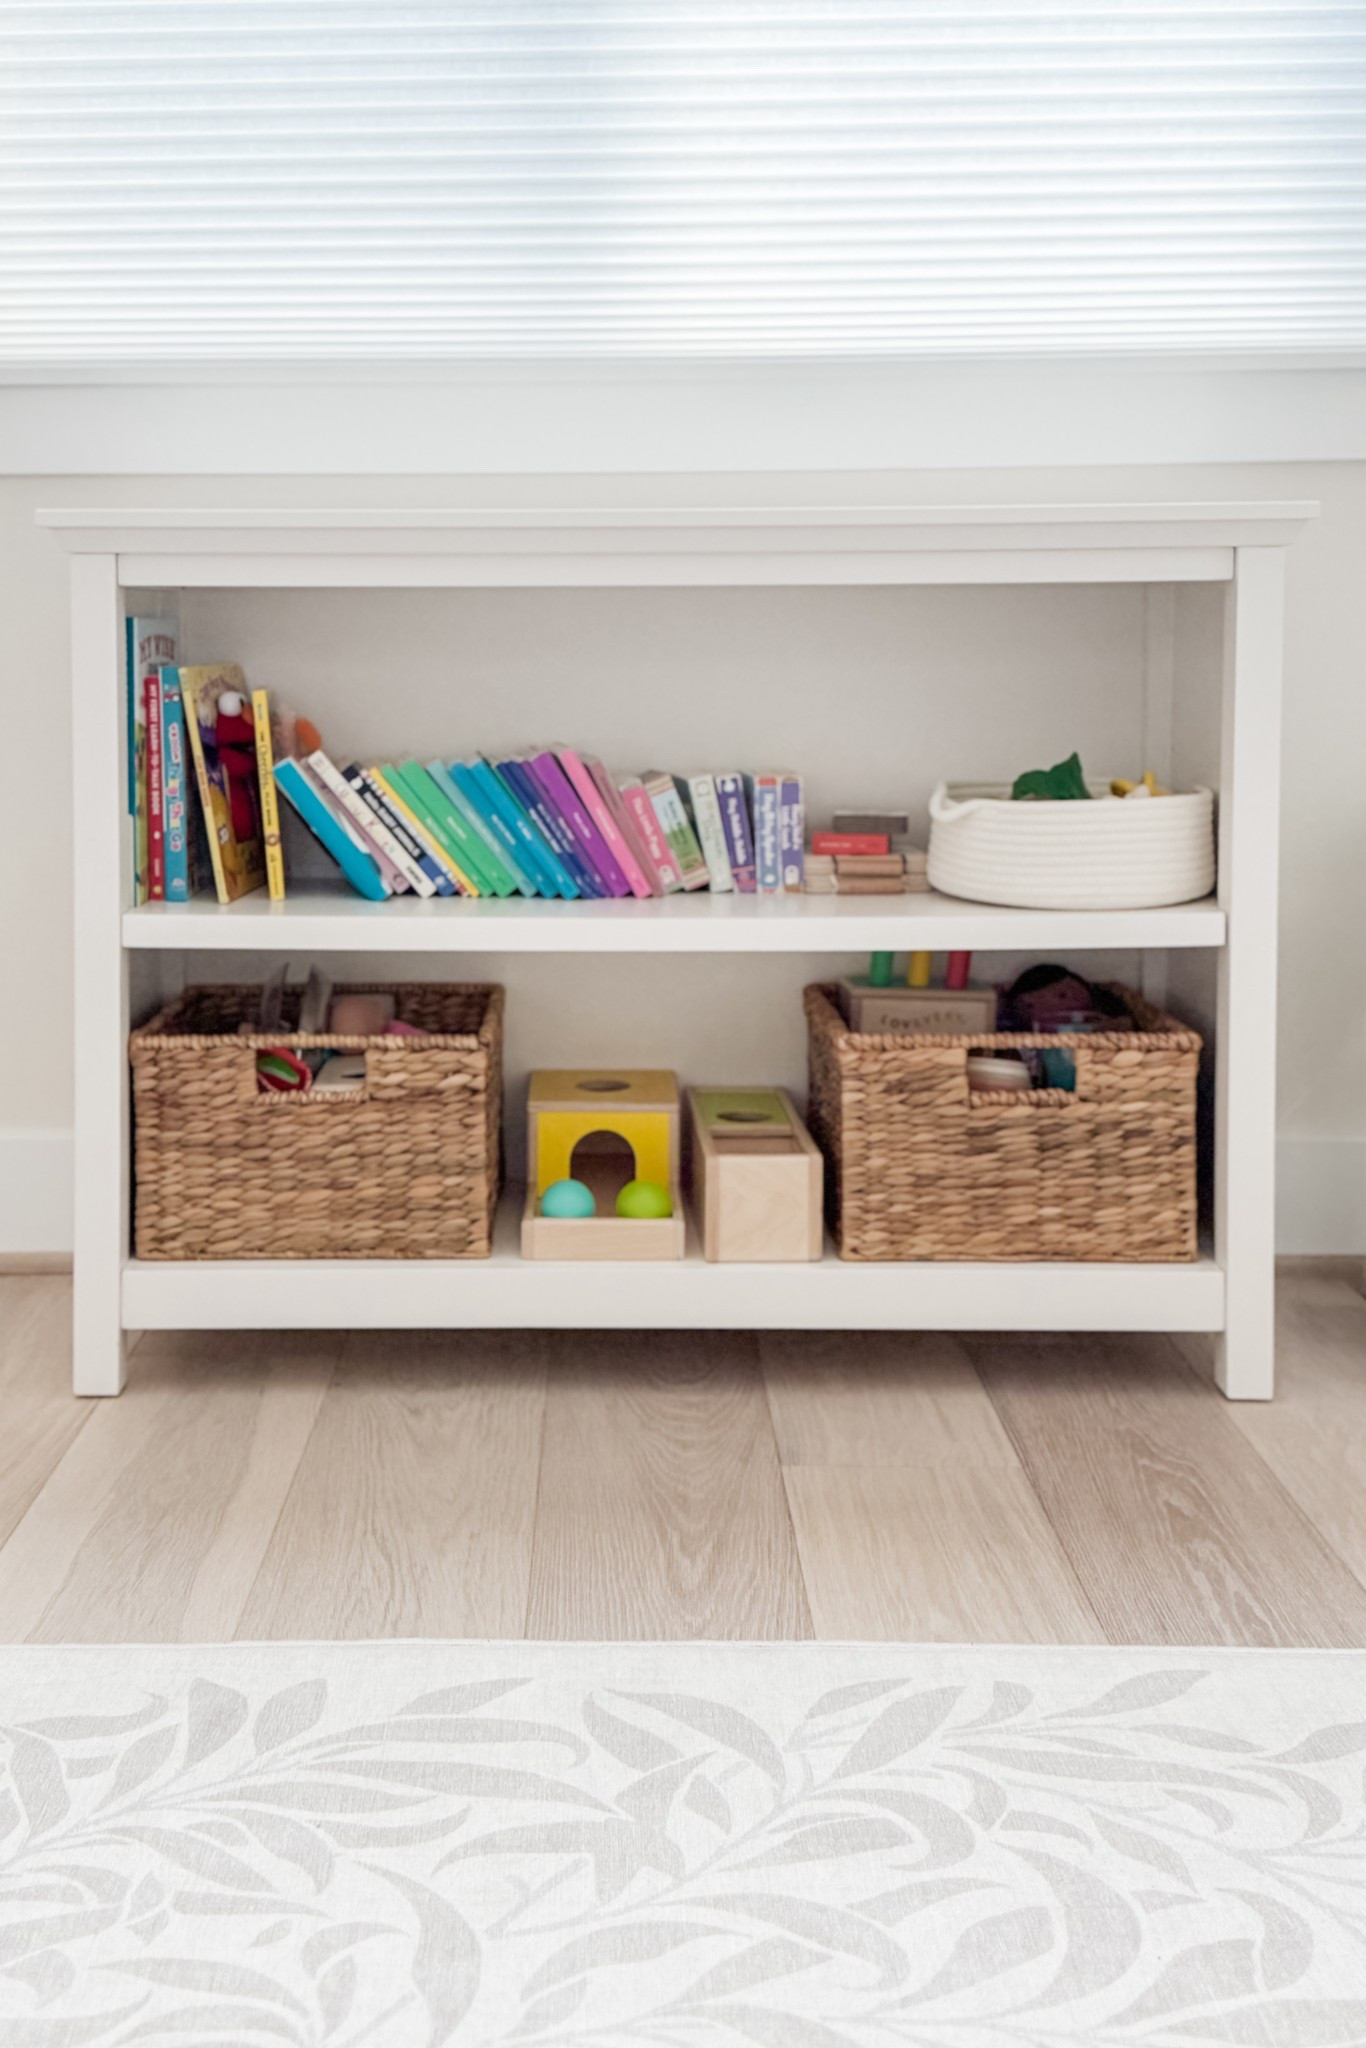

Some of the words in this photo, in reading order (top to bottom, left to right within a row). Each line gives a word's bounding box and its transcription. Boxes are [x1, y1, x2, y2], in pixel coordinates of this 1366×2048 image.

[148, 684, 156, 696] MY
[148, 698, 157, 722] FIRST
[151, 790, 160, 815] BOOK
